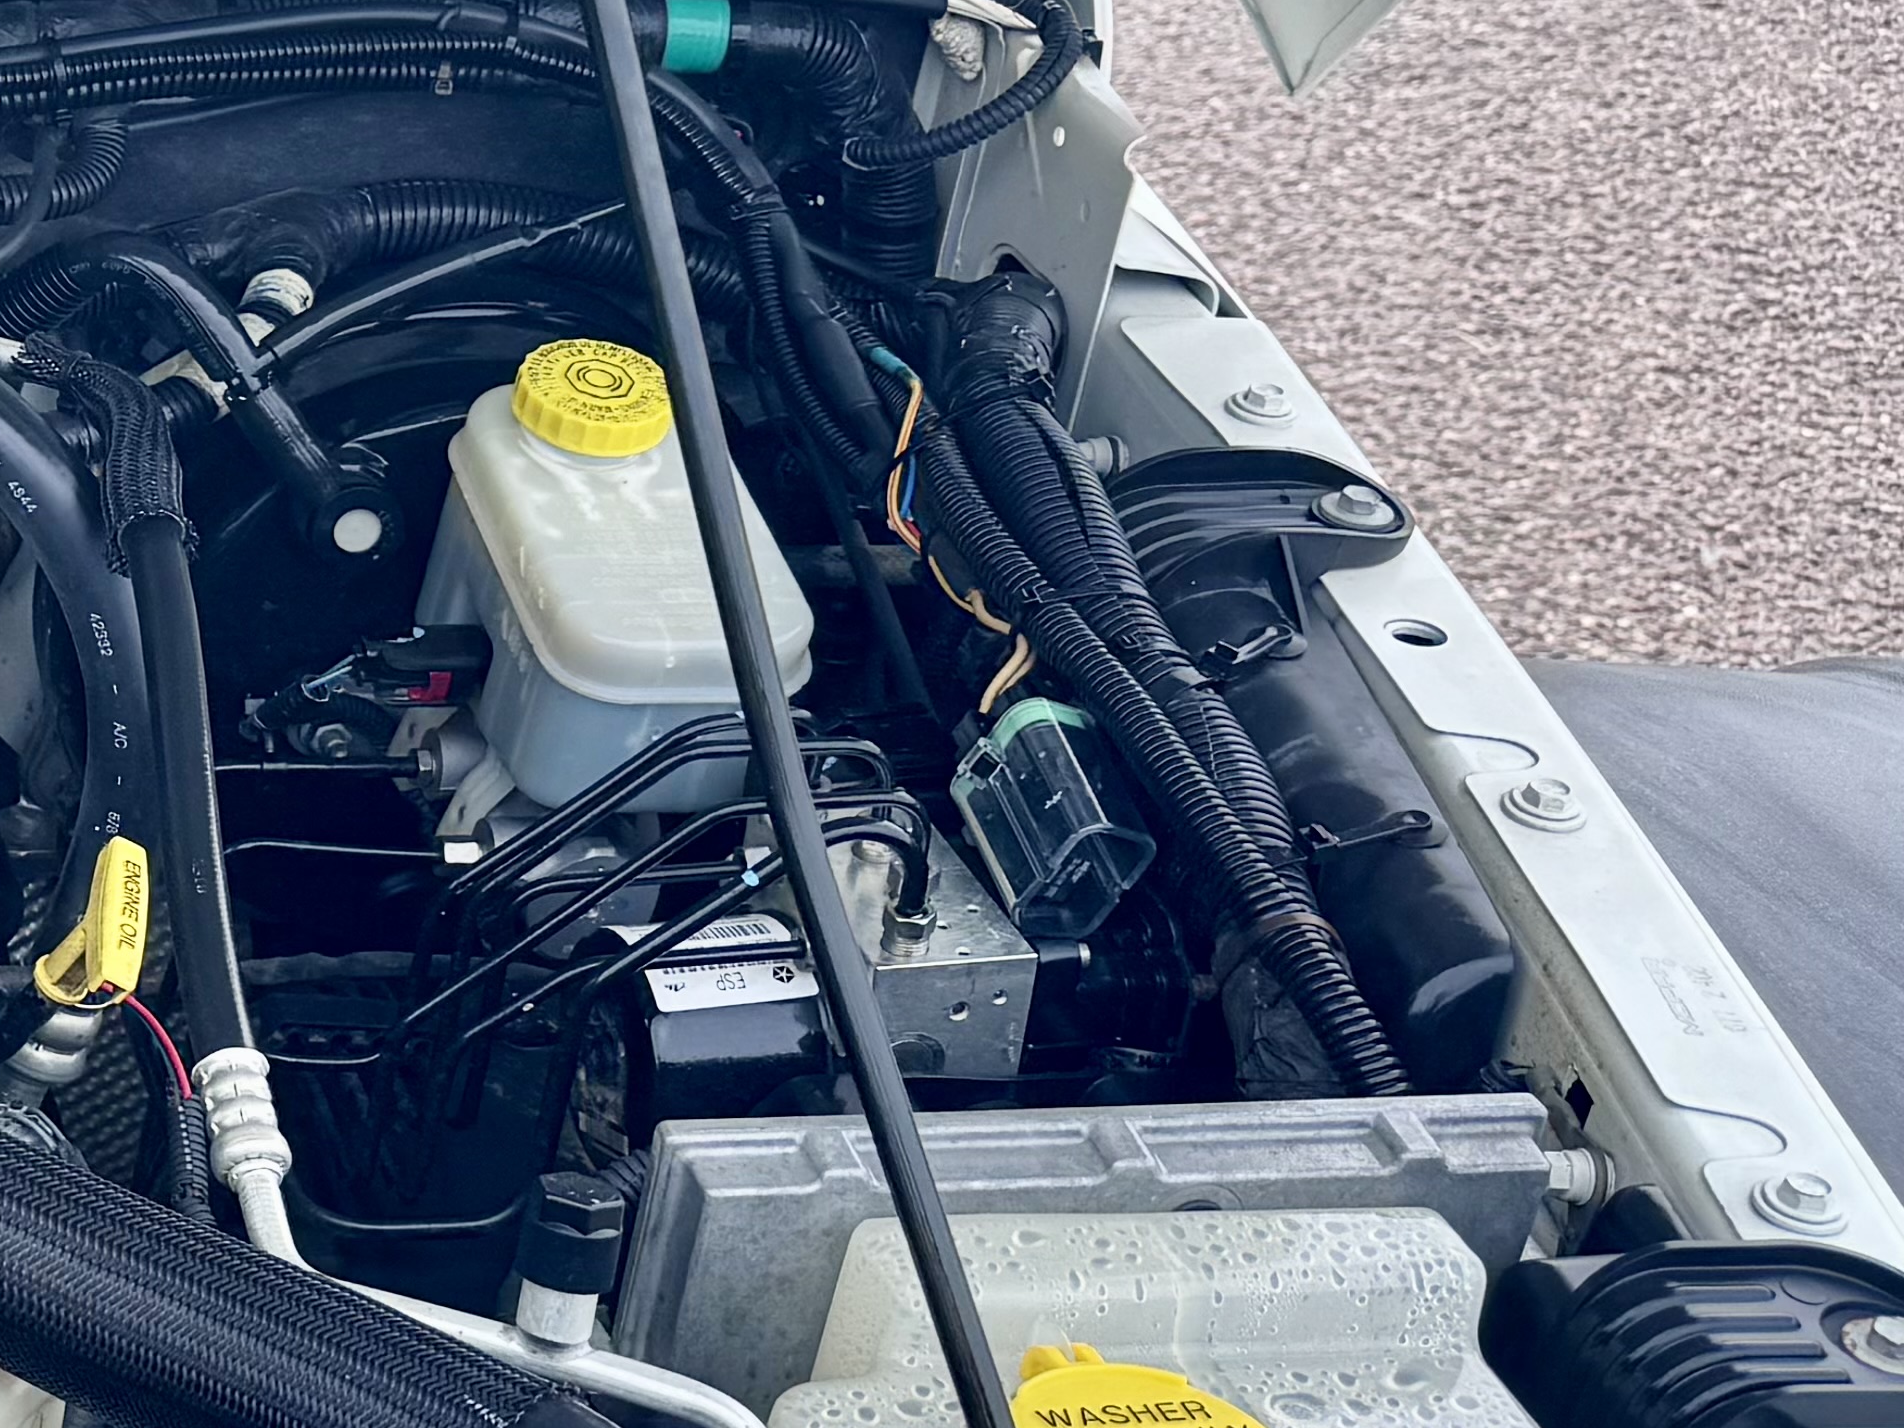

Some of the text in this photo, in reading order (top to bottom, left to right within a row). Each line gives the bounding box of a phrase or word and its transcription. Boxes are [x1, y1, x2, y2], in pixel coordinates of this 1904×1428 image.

[118, 859, 142, 951] ENGINE OIL
[716, 971, 747, 992] ESP
[1034, 1398, 1213, 1428] WASHER
